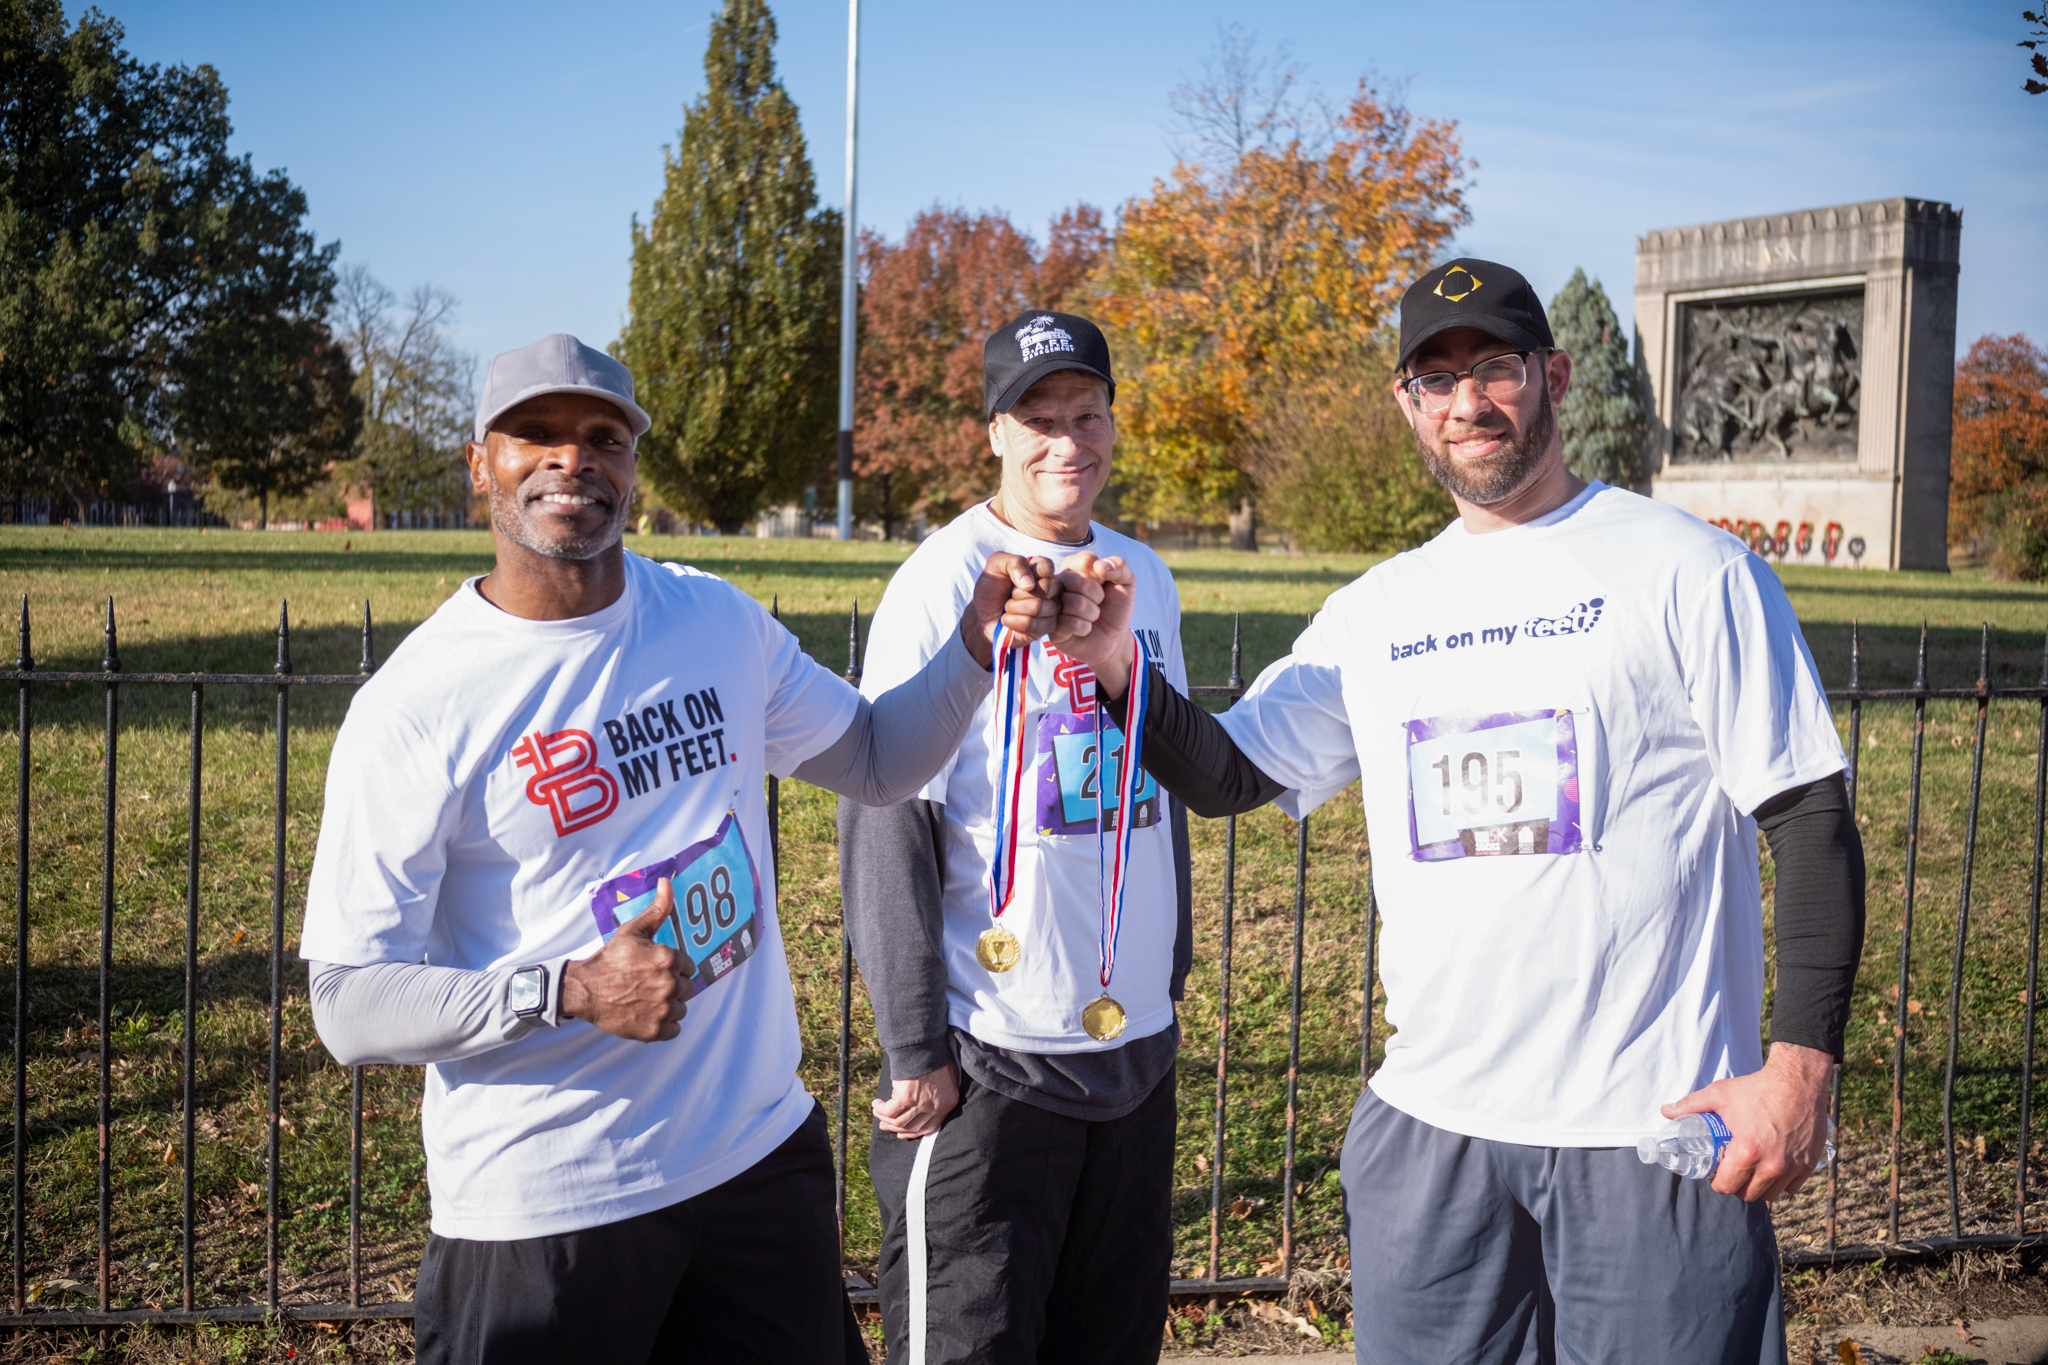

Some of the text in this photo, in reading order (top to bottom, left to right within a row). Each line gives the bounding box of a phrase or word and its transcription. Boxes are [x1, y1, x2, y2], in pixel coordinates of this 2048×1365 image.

[1022, 338, 1074, 357] S.A.F.E.
[1391, 602, 1588, 661] back on my feet
[603, 687, 725, 758] BACK ON
[618, 728, 737, 799] MY FEET.
[1080, 743, 1146, 801] 21
[1432, 750, 1523, 816] 195
[720, 940, 736, 961] 5K
